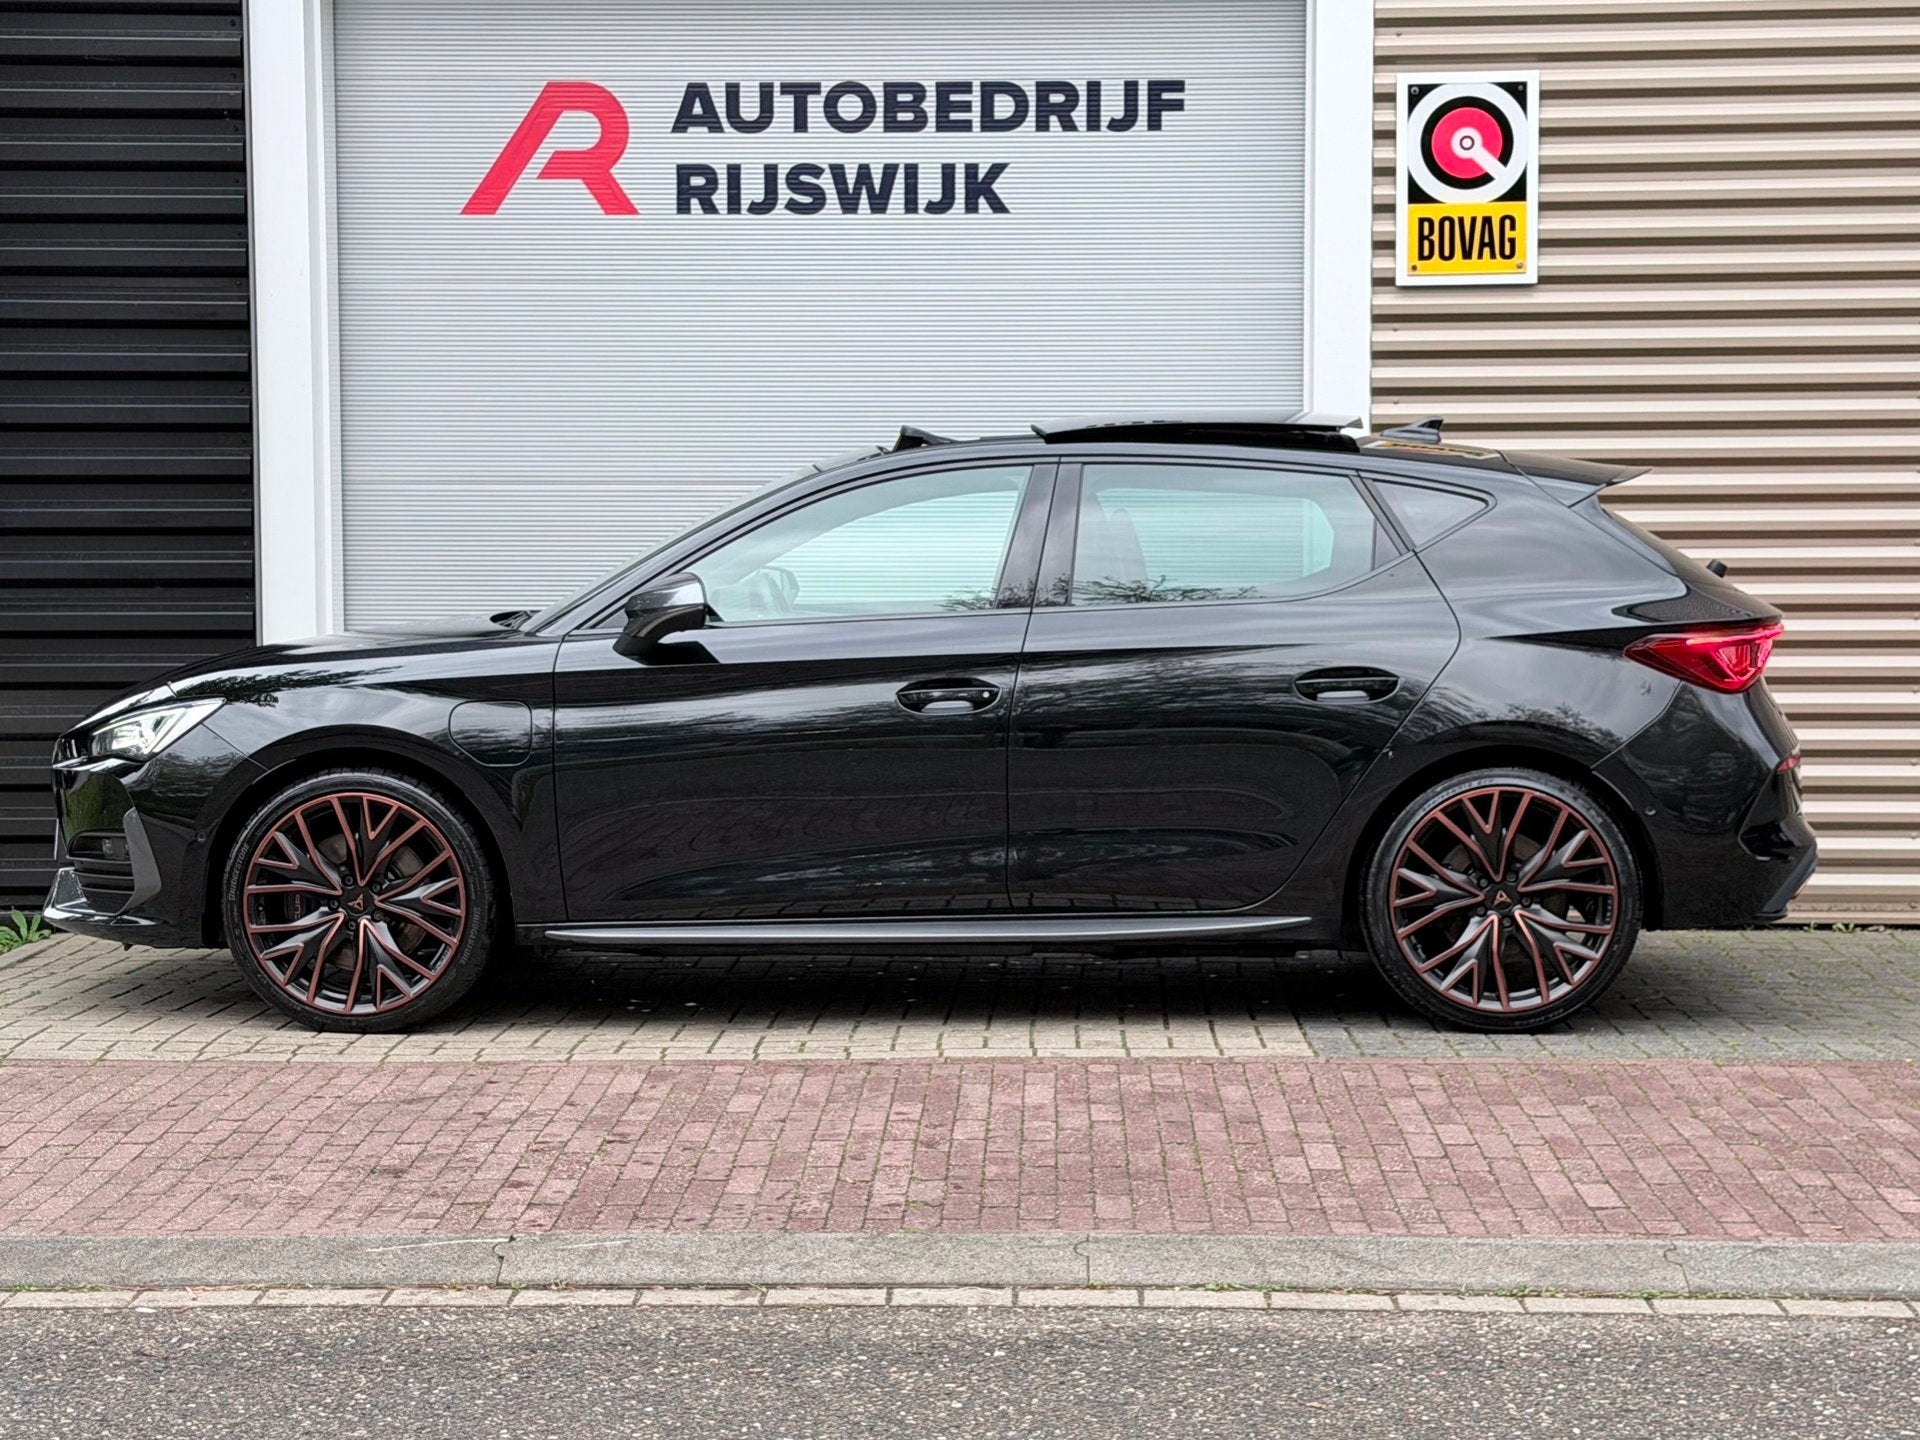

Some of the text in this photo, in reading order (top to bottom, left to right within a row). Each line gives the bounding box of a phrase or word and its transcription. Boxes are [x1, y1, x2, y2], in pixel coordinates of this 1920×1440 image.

[671, 80, 1186, 134] AUTOBEDRIJF
[676, 163, 1011, 216] RIJSWIJK
[1417, 214, 1517, 262] BOVAG
[228, 841, 249, 901] BRIDGESTONE
